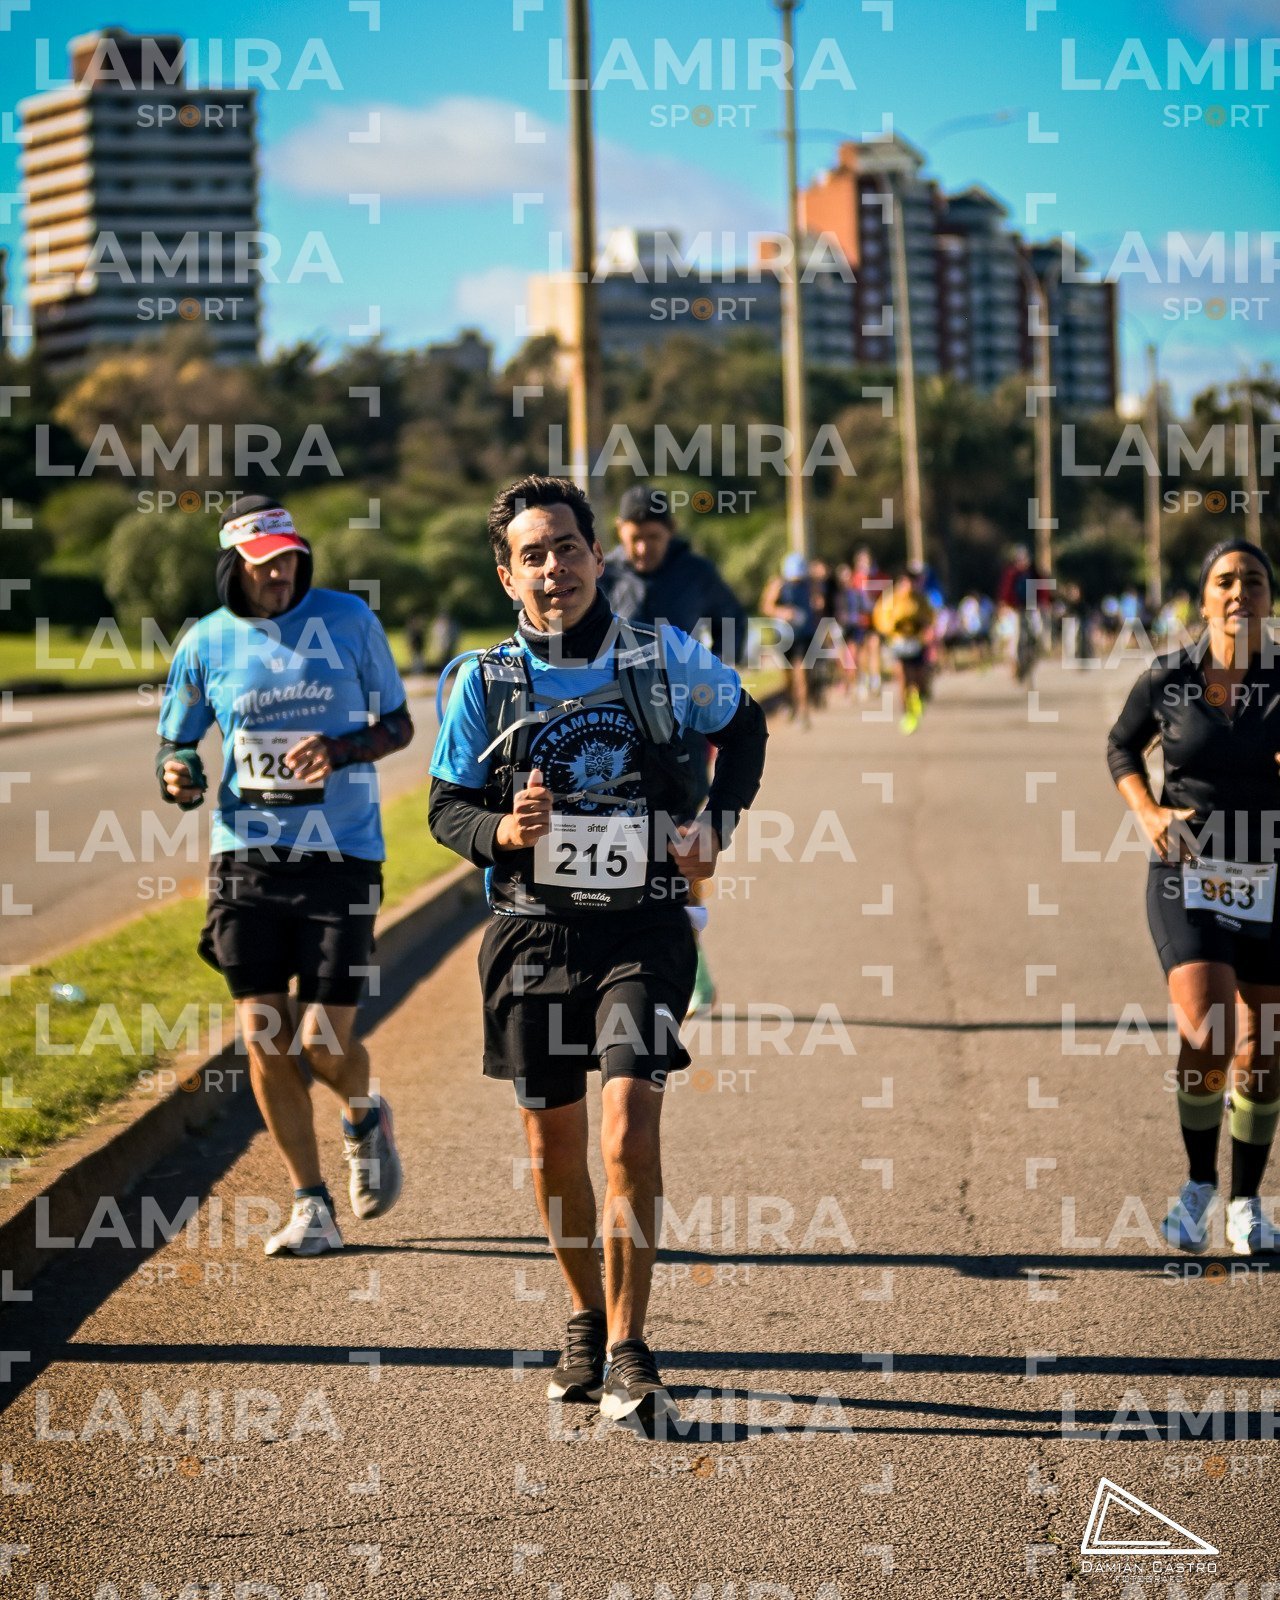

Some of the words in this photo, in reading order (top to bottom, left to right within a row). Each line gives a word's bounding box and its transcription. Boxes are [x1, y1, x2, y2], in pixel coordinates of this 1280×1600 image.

[233, 680, 334, 715] Maratón
[555, 842, 628, 878] 215
[571, 891, 611, 903] Maratón
[1201, 879, 1256, 910] 963
